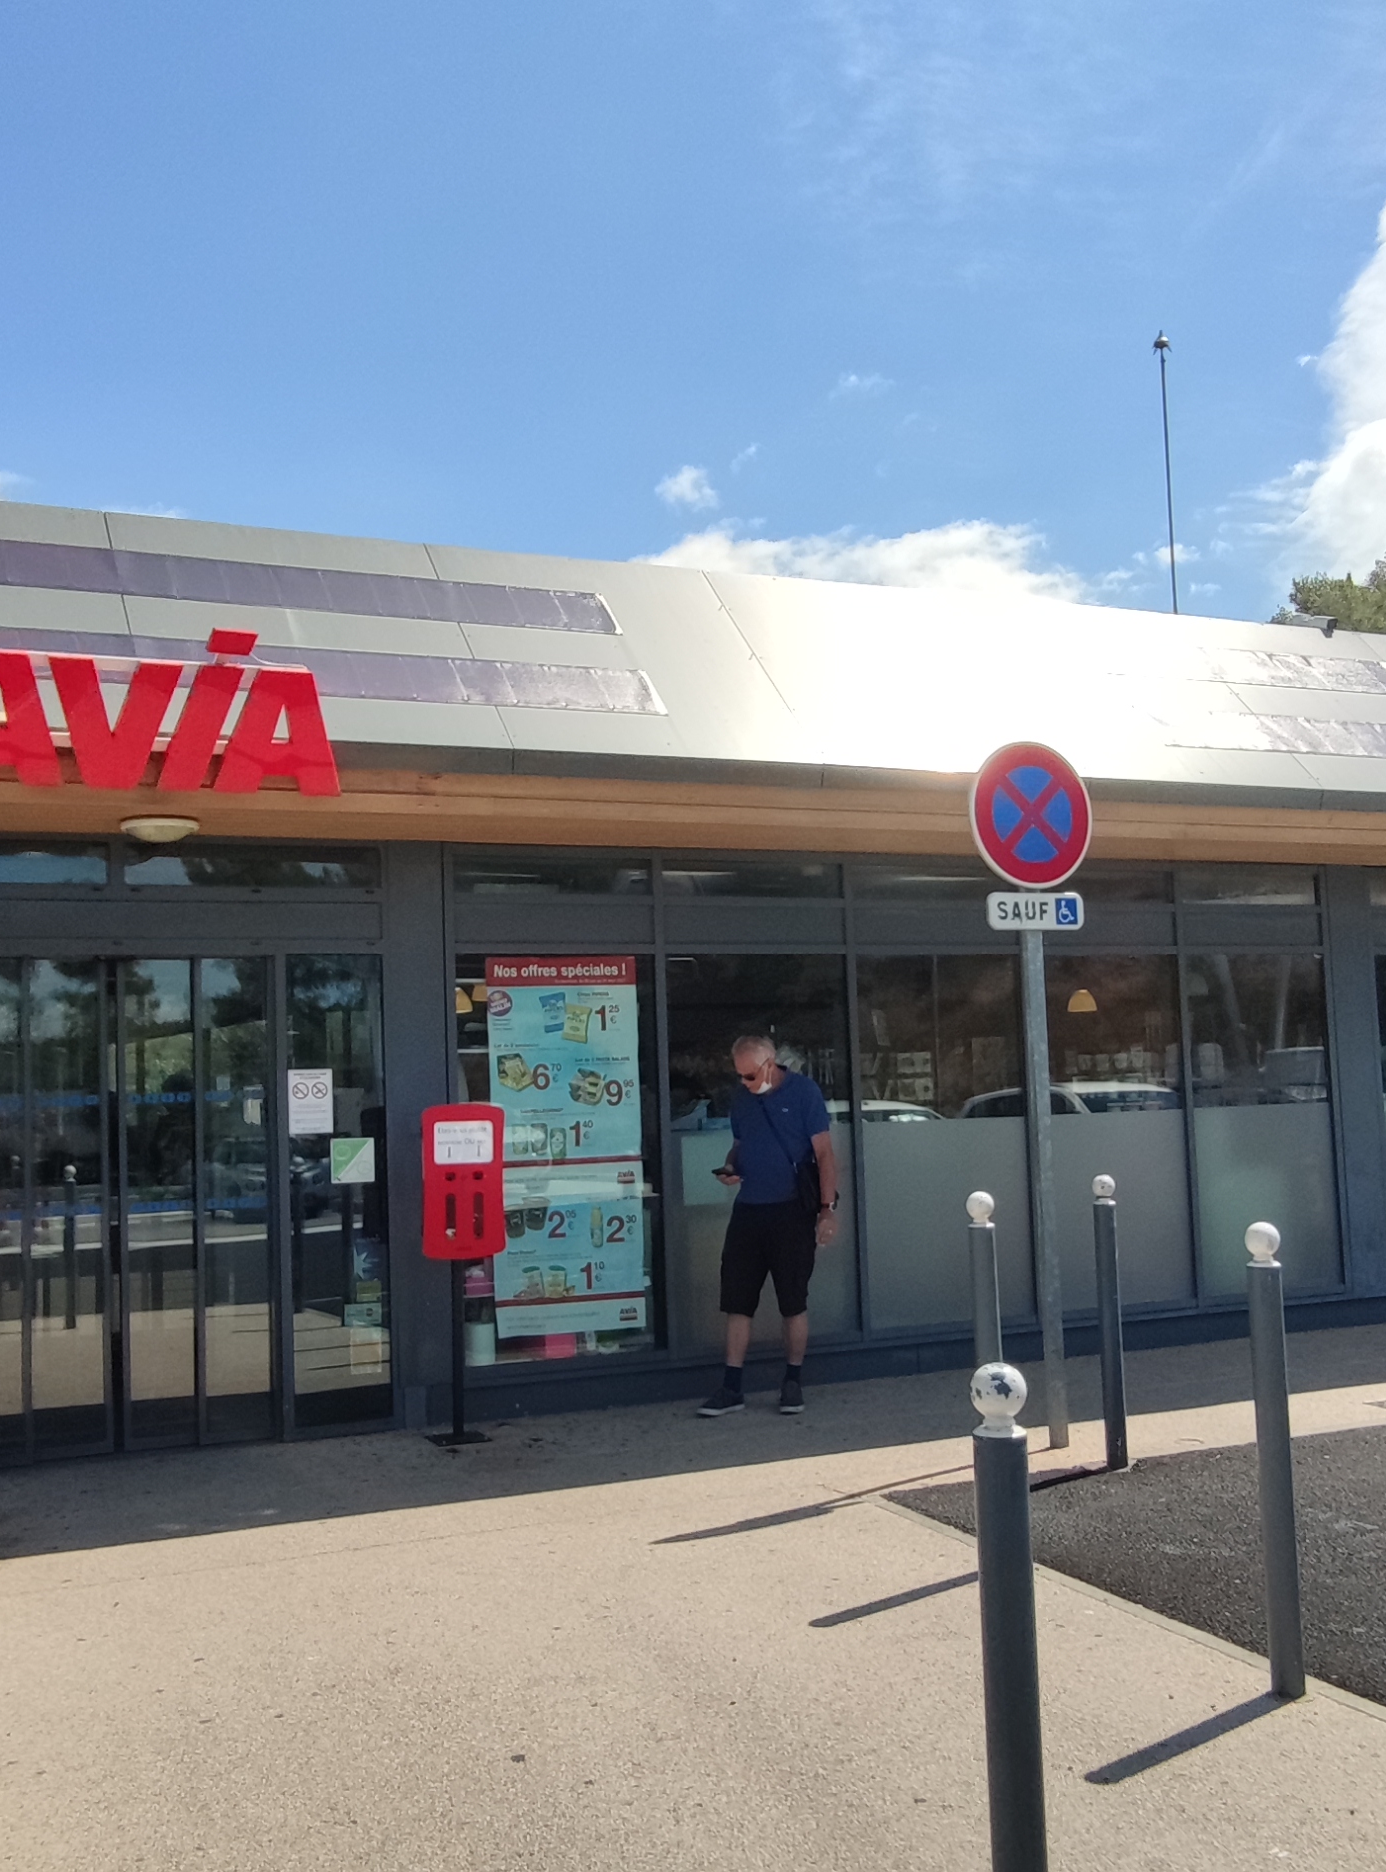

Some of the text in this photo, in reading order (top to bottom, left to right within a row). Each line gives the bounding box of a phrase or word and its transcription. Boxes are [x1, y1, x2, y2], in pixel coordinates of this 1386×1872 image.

[997, 900, 1049, 922] SAUF
[493, 964, 517, 978] Nos
[521, 963, 558, 978] offres
[561, 963, 618, 978] spéciales
[594, 1004, 607, 1031] 1
[608, 1004, 620, 1013] 25
[532, 1063, 551, 1091] 6
[551, 1063, 562, 1072] 70
[605, 1079, 623, 1106] 9
[623, 1079, 634, 1088] 95
[569, 1120, 581, 1147] 1
[582, 1120, 594, 1128] 40
[548, 1210, 566, 1238] 2
[566, 1210, 576, 1218] 05
[606, 1215, 625, 1242] 2
[625, 1214, 637, 1223] 30
[580, 1262, 592, 1289] 1
[594, 1261, 604, 1270] 10
